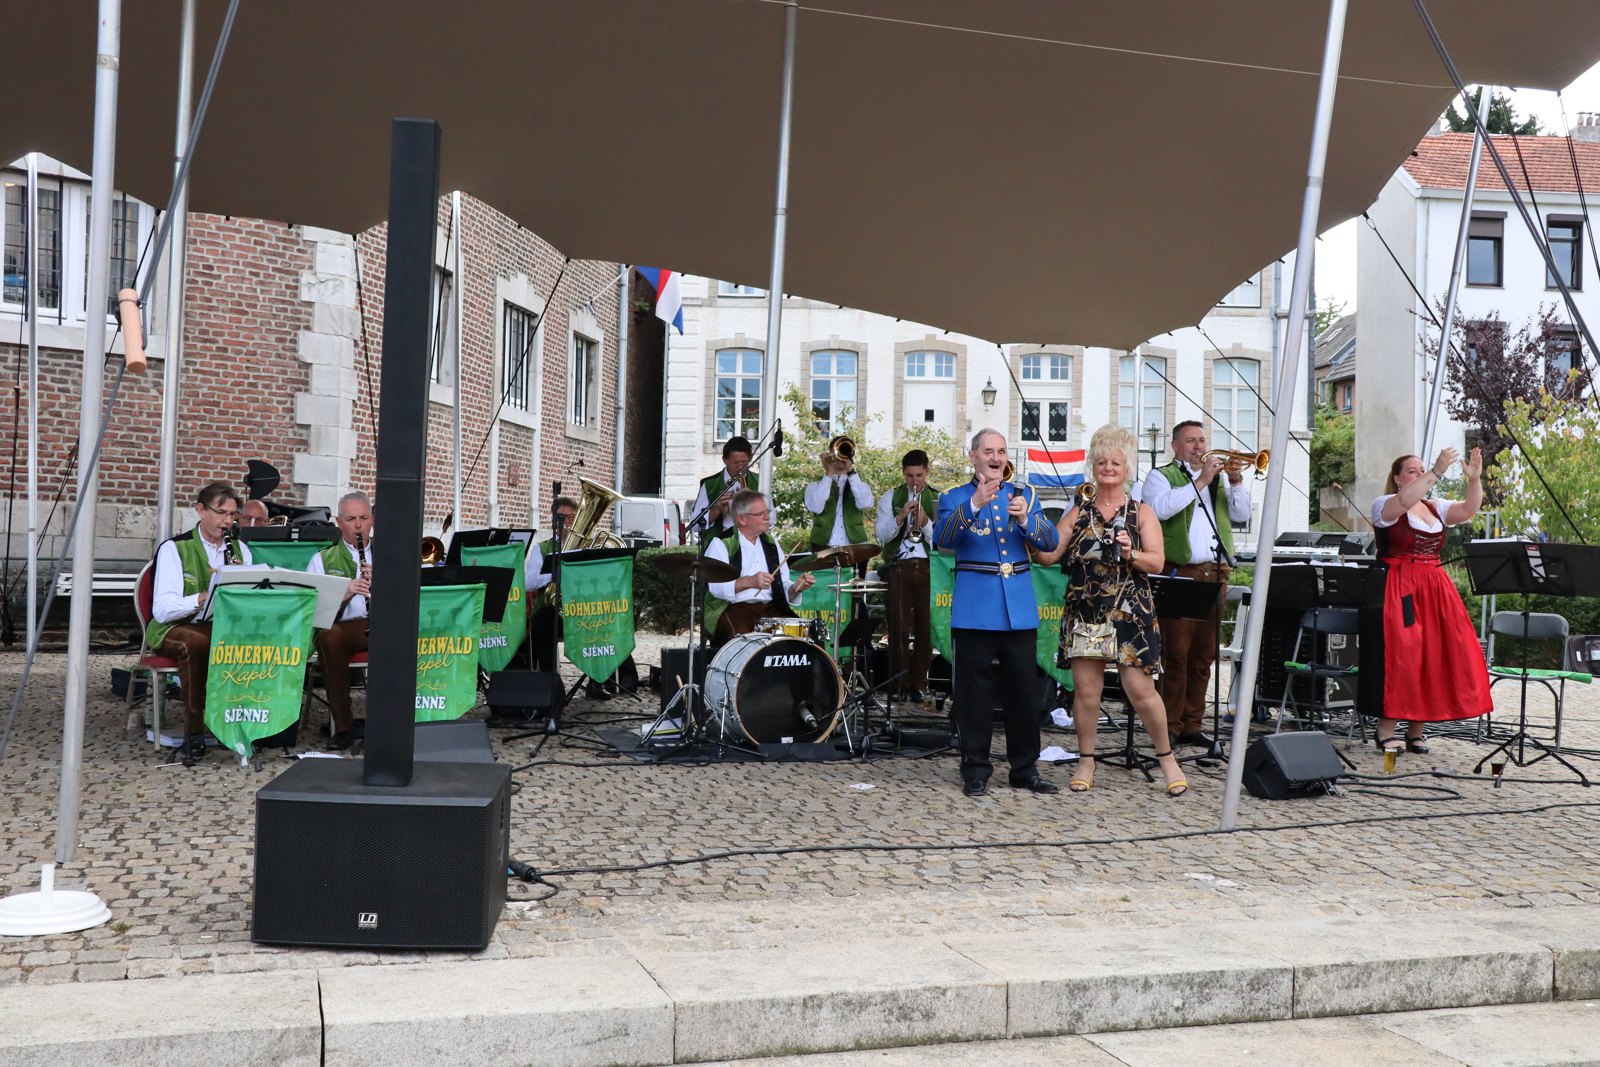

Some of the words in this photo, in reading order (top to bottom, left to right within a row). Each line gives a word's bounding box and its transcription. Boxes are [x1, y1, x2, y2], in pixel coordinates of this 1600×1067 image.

[564, 598, 628, 616] BÖHMERWALD
[577, 612, 616, 632] Kapel
[417, 636, 473, 655] ERWALD
[416, 650, 454, 677] apel
[772, 654, 808, 667] TAMA
[221, 658, 280, 689] Kapel
